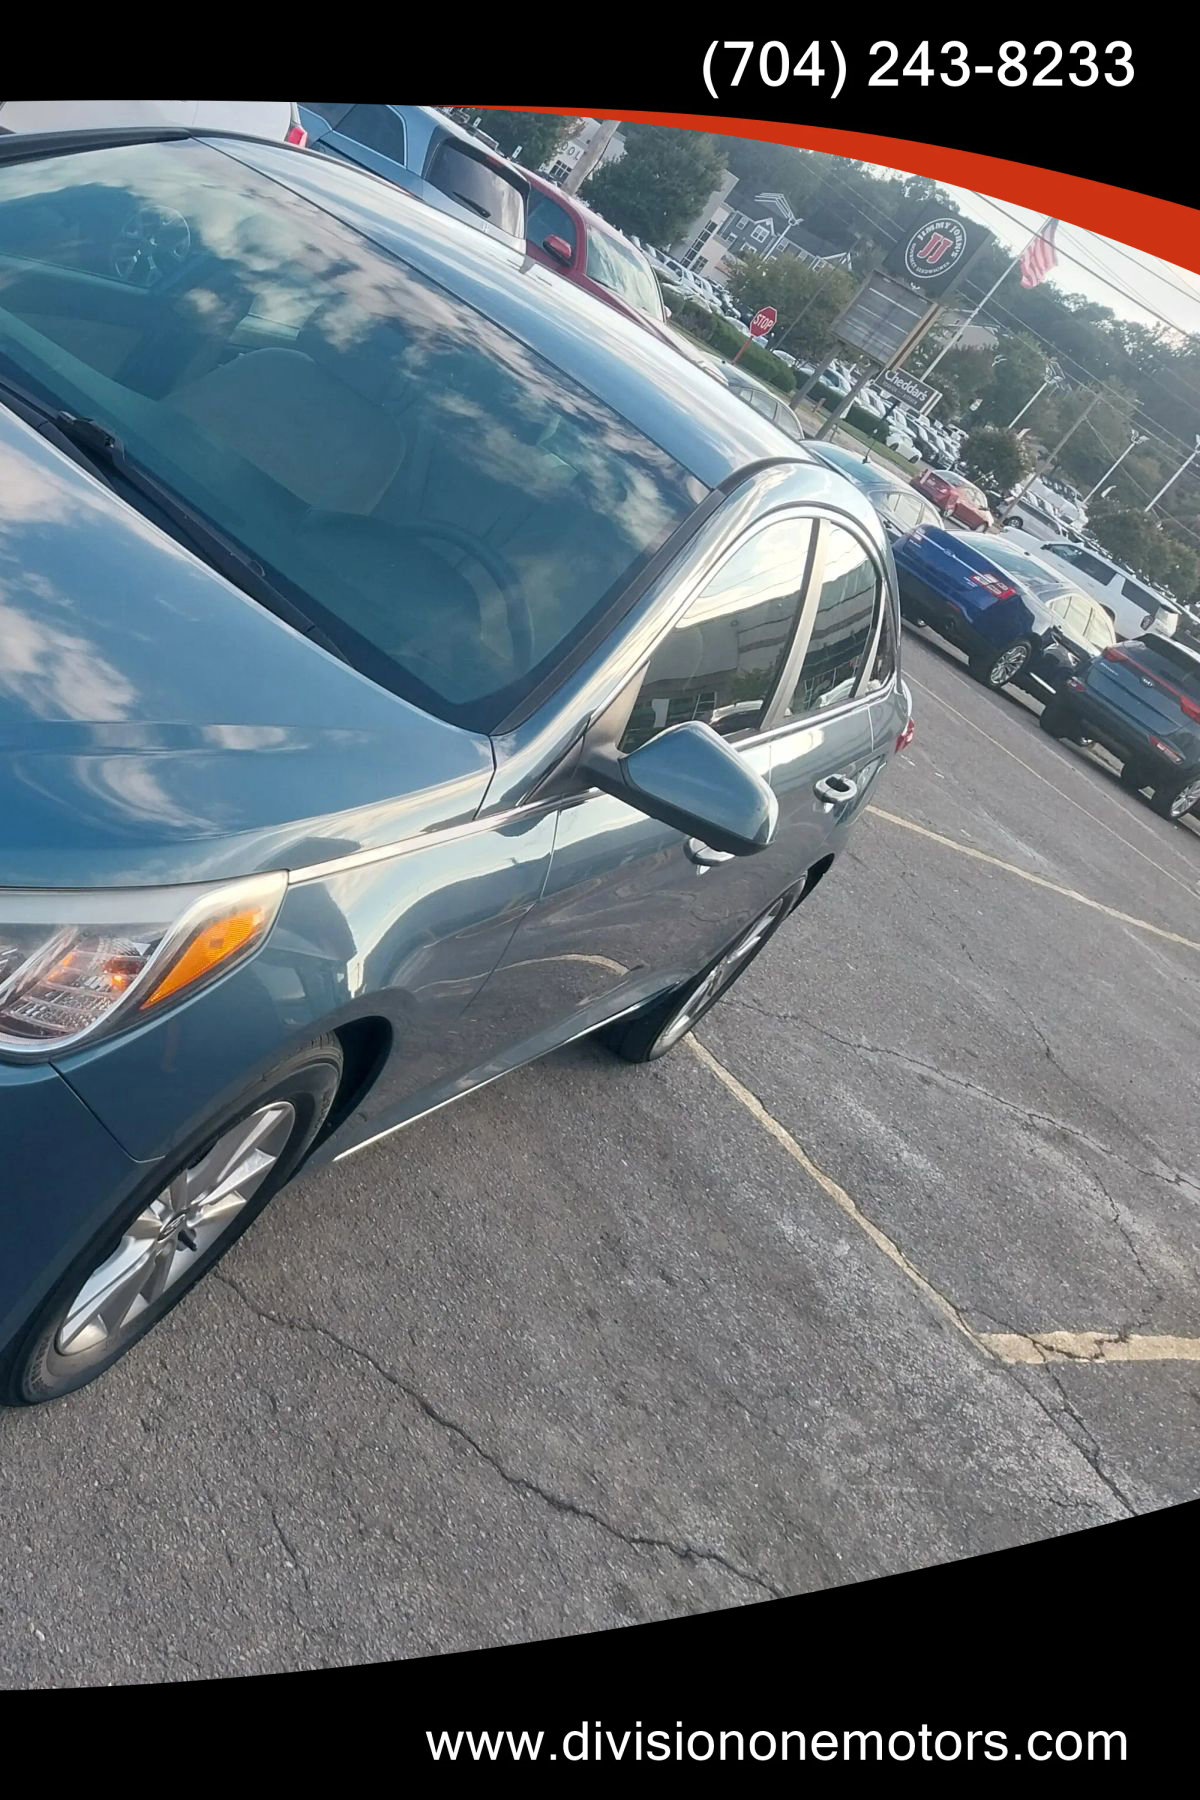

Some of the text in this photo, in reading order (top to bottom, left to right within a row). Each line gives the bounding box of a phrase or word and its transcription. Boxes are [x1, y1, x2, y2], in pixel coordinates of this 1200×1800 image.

[916, 231, 954, 264] JJ
[753, 313, 774, 330] STOP
[884, 369, 928, 402] Cheddar's
